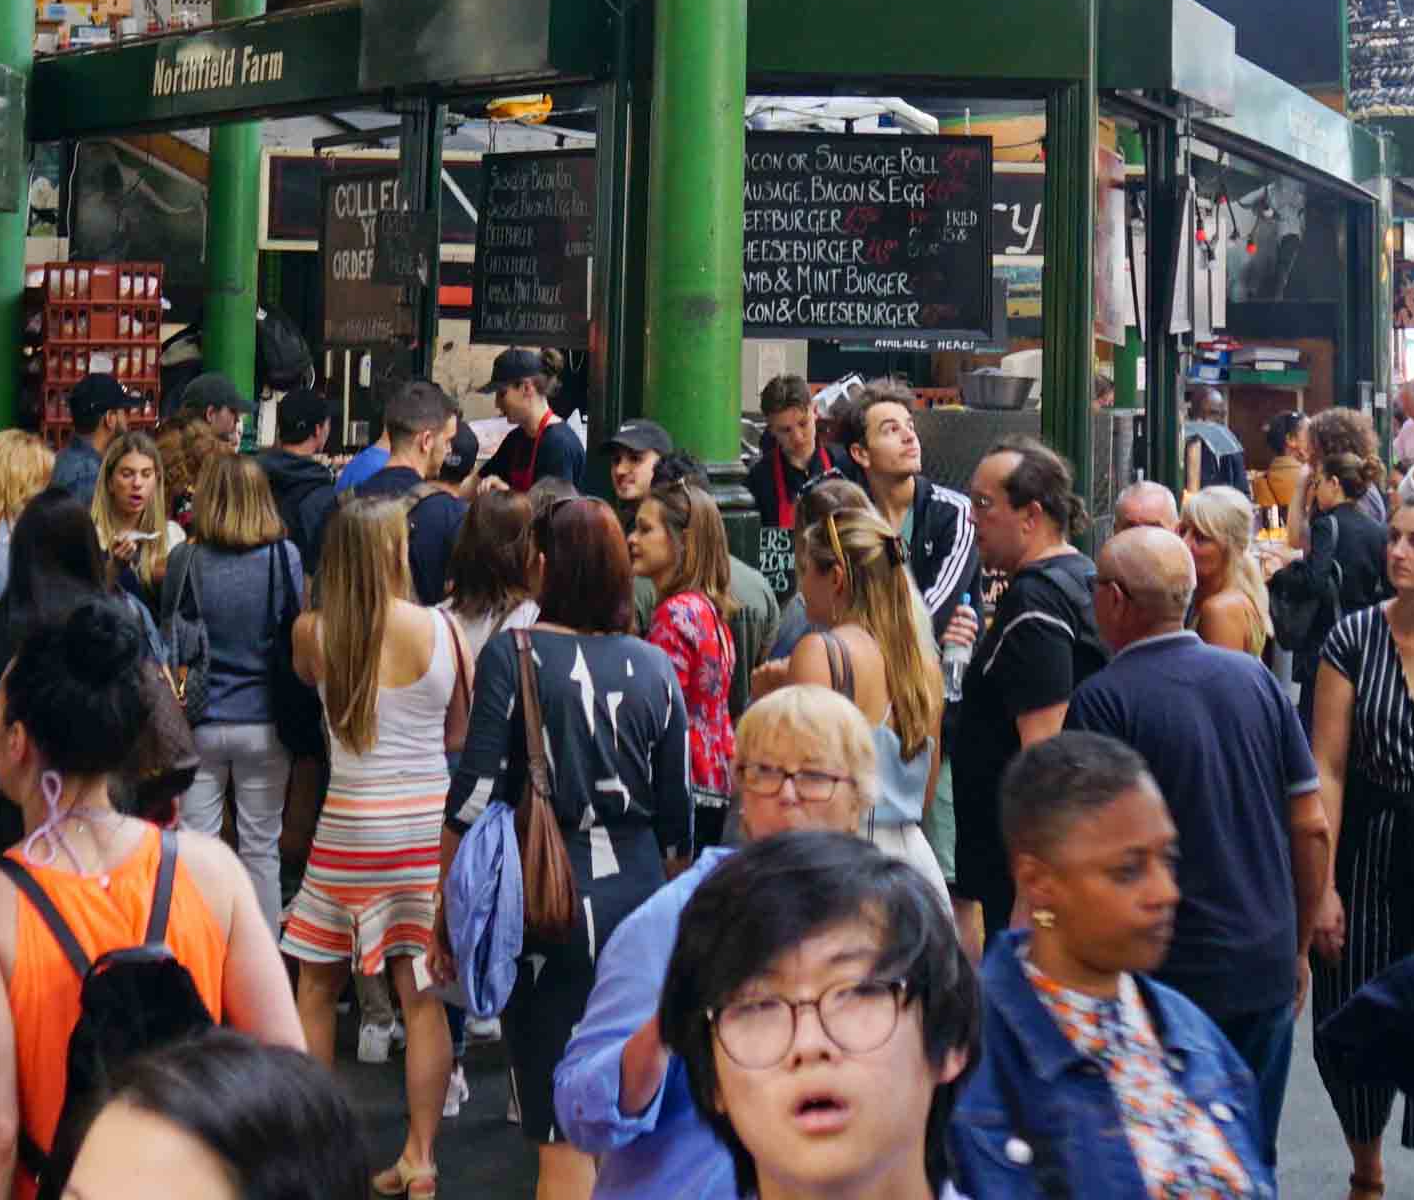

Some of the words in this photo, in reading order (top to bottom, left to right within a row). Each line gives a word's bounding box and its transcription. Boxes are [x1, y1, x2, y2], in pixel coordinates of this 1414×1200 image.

[152, 48, 236, 96] Northfield
[241, 45, 284, 85] Farm
[786, 152, 811, 172] OR
[900, 146, 940, 177] ROLL
[744, 179, 808, 204] AUSAGE,
[810, 175, 866, 202] BACON
[868, 179, 885, 202] &
[888, 178, 925, 207] EGG
[743, 207, 844, 237] EEFBURGER
[744, 238, 867, 267] HEESEBURGER
[773, 269, 793, 295] &
[796, 264, 843, 294] MINT
[845, 266, 915, 298] BURGER
